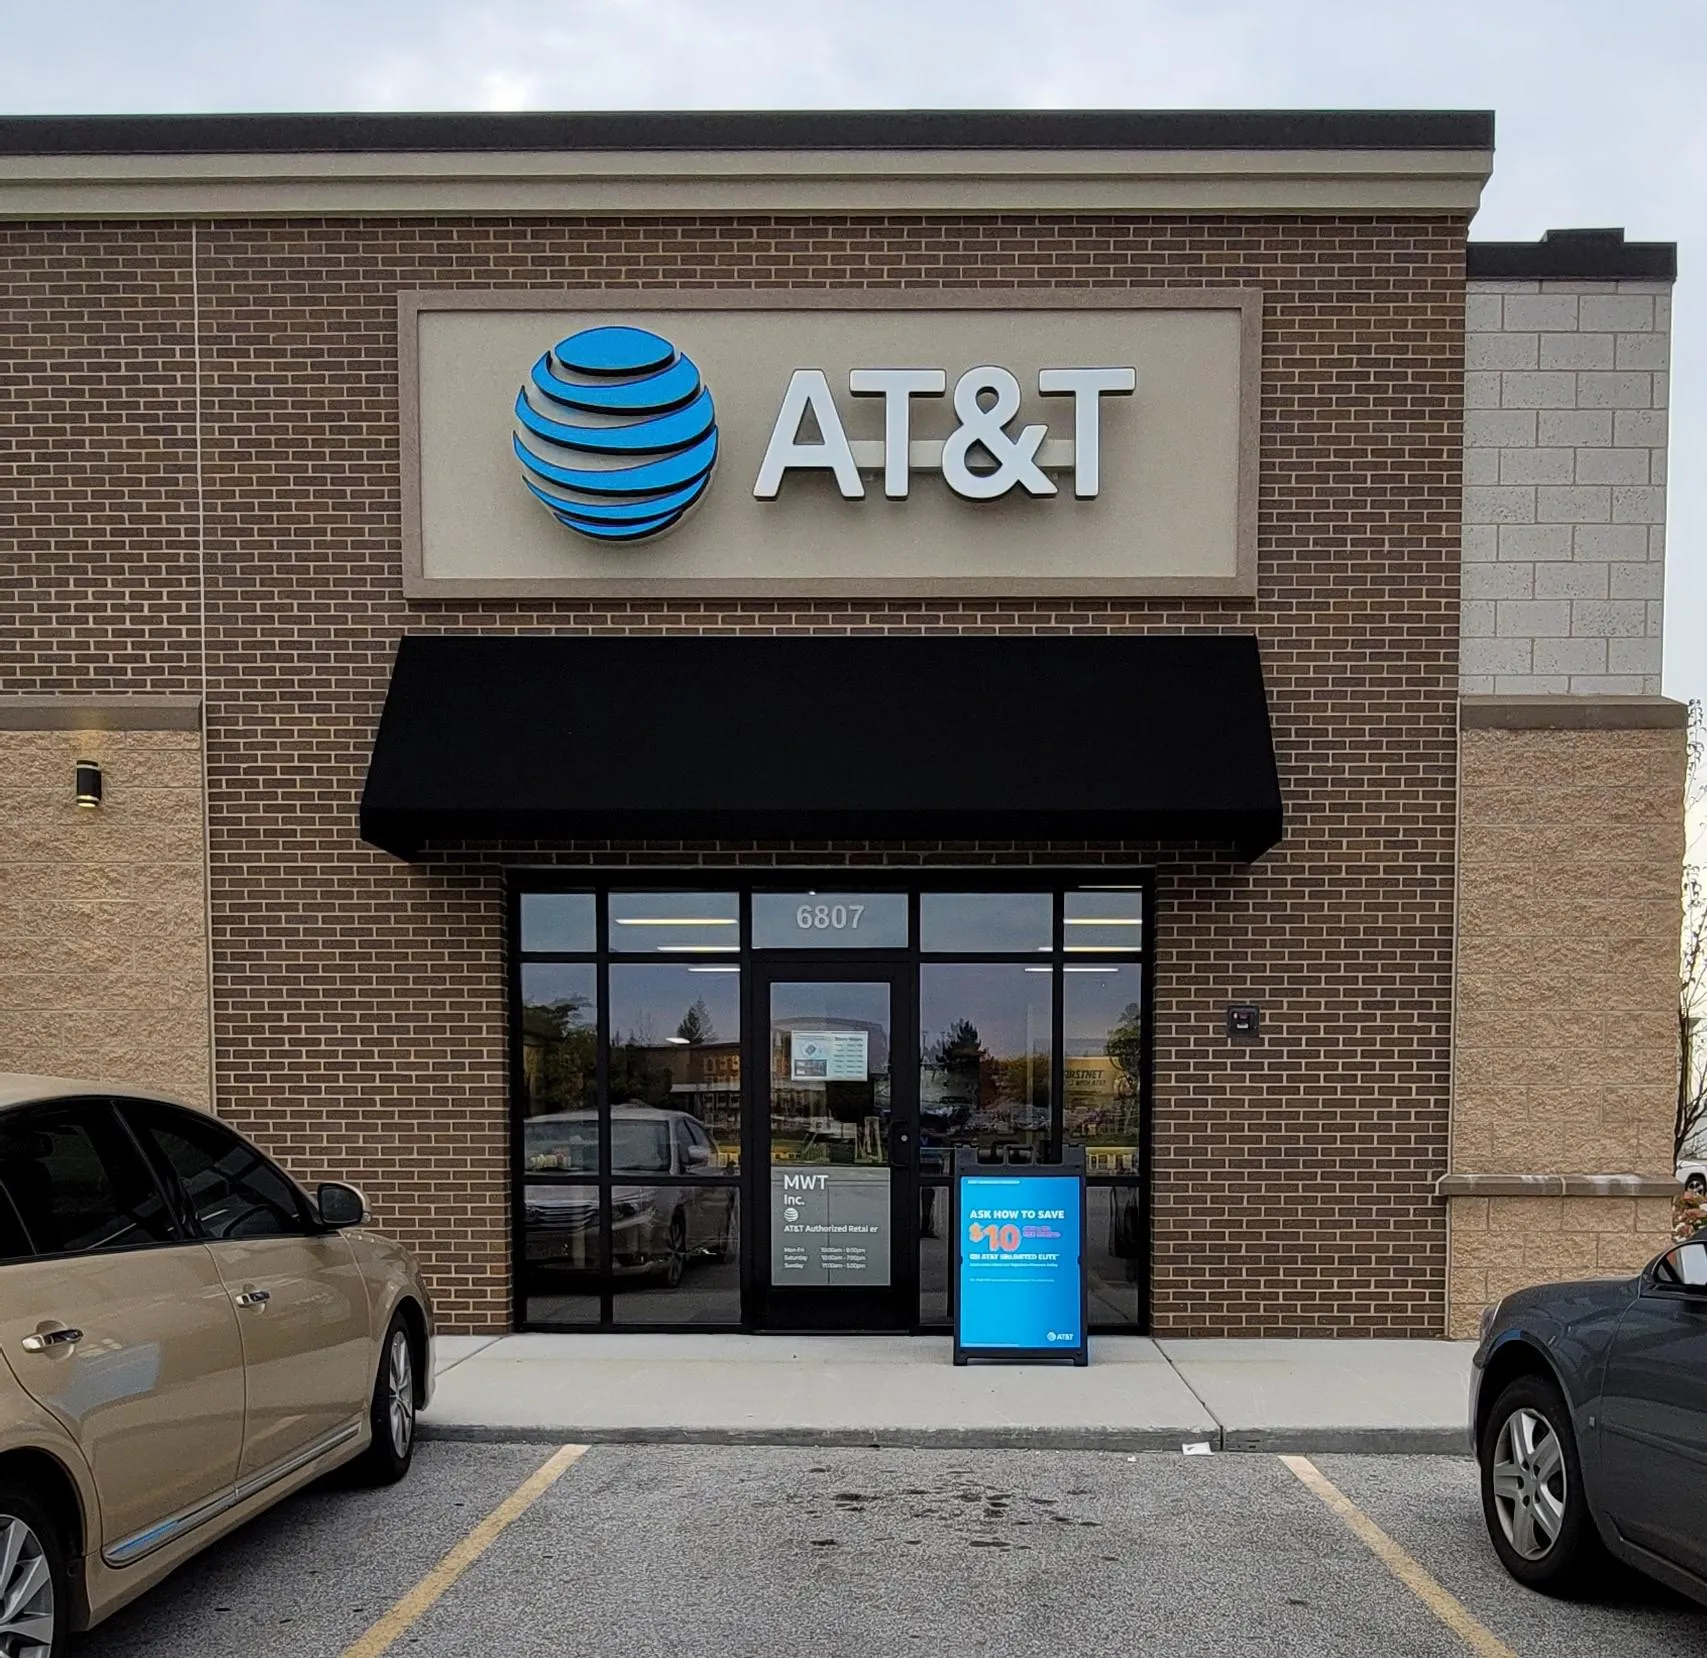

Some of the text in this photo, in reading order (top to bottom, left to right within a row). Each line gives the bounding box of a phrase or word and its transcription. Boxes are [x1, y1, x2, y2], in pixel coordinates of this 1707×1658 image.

[752, 366, 1136, 499] AT&T
[797, 904, 865, 929] 6807
[783, 1174, 829, 1190] MWT
[783, 1194, 805, 1206] Inc.
[969, 1210, 1065, 1219] ASK HOW TO SAVE
[783, 1225, 804, 1233] AT&T
[805, 1224, 847, 1233] Authorized
[969, 1222, 1021, 1252] $10
[1056, 1333, 1074, 1341] AT&T
